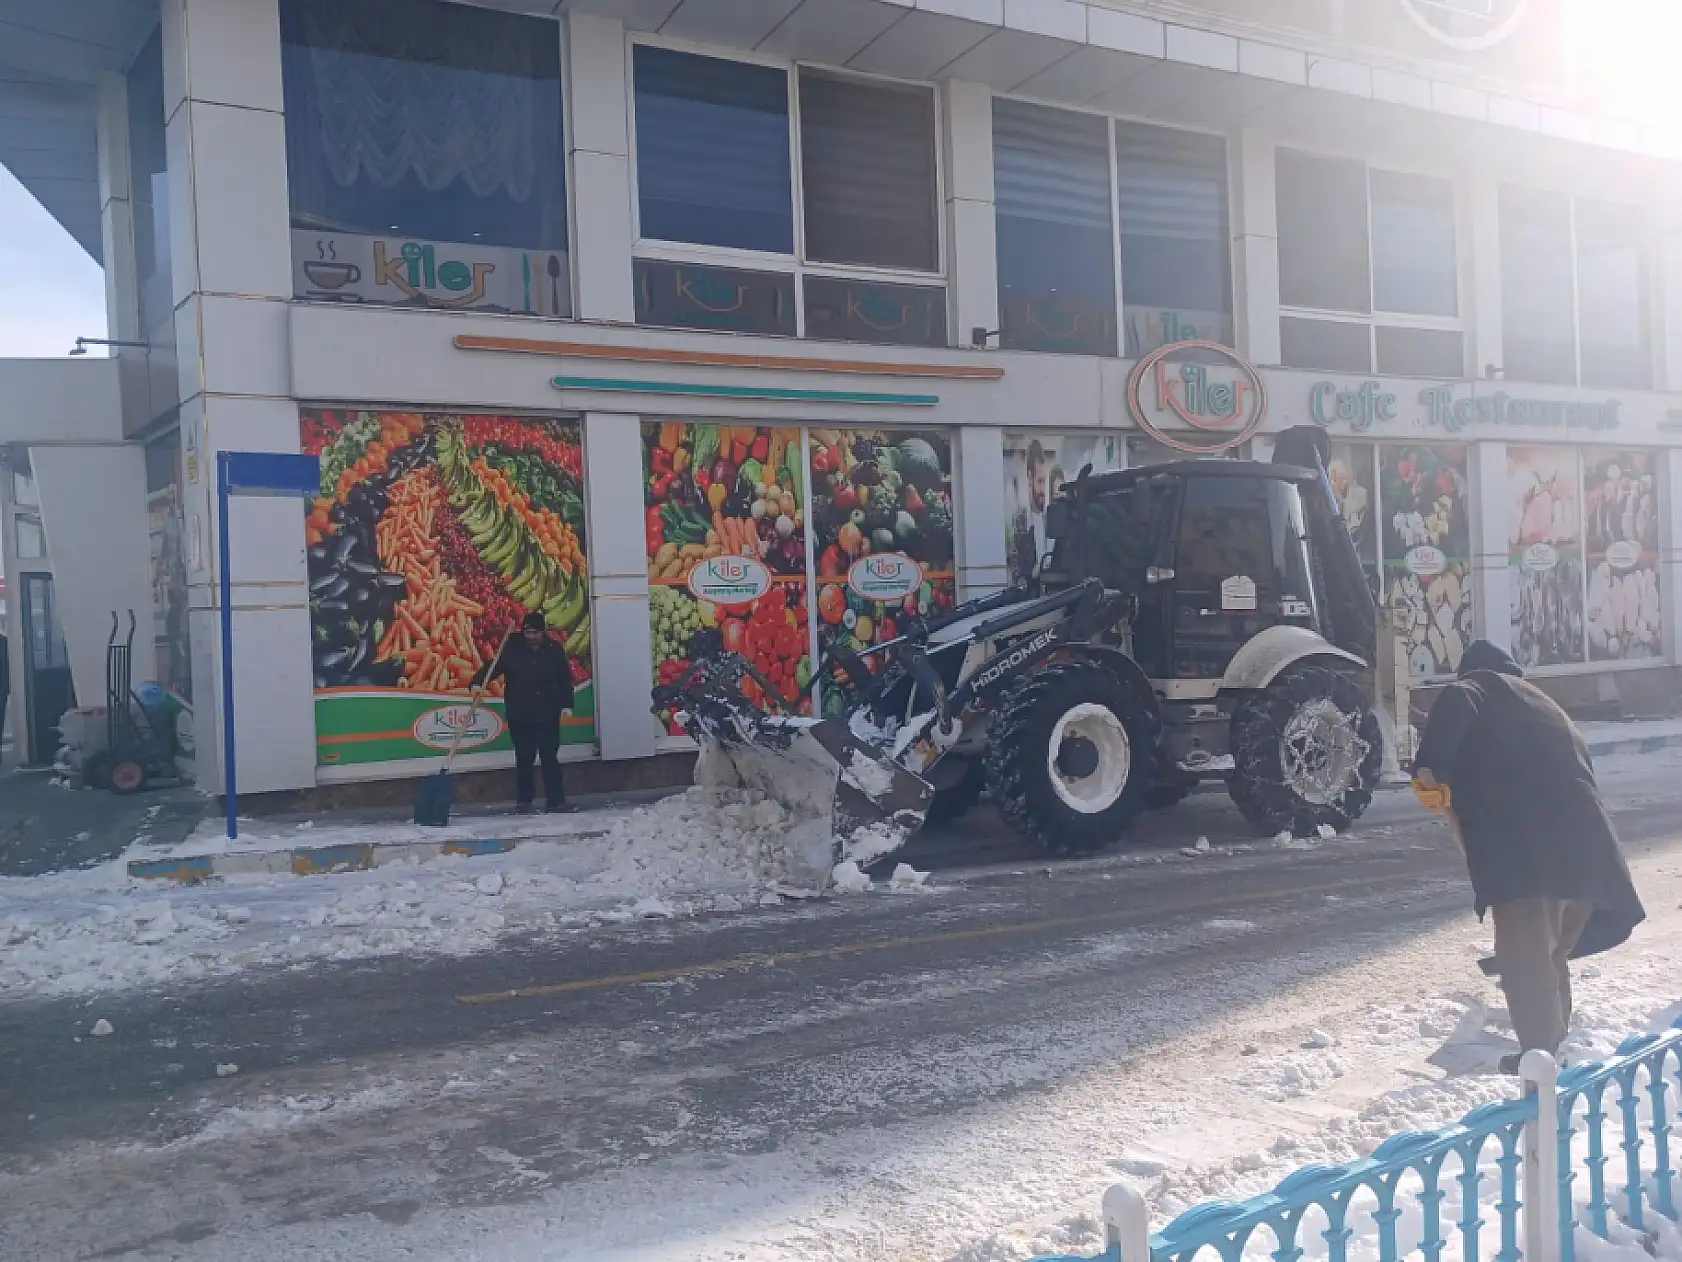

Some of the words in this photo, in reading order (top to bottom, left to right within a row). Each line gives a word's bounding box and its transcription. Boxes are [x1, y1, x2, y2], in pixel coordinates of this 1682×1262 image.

[372, 240, 496, 308] kiler
[1154, 359, 1250, 430] kiler
[1310, 380, 1398, 432] Cafe
